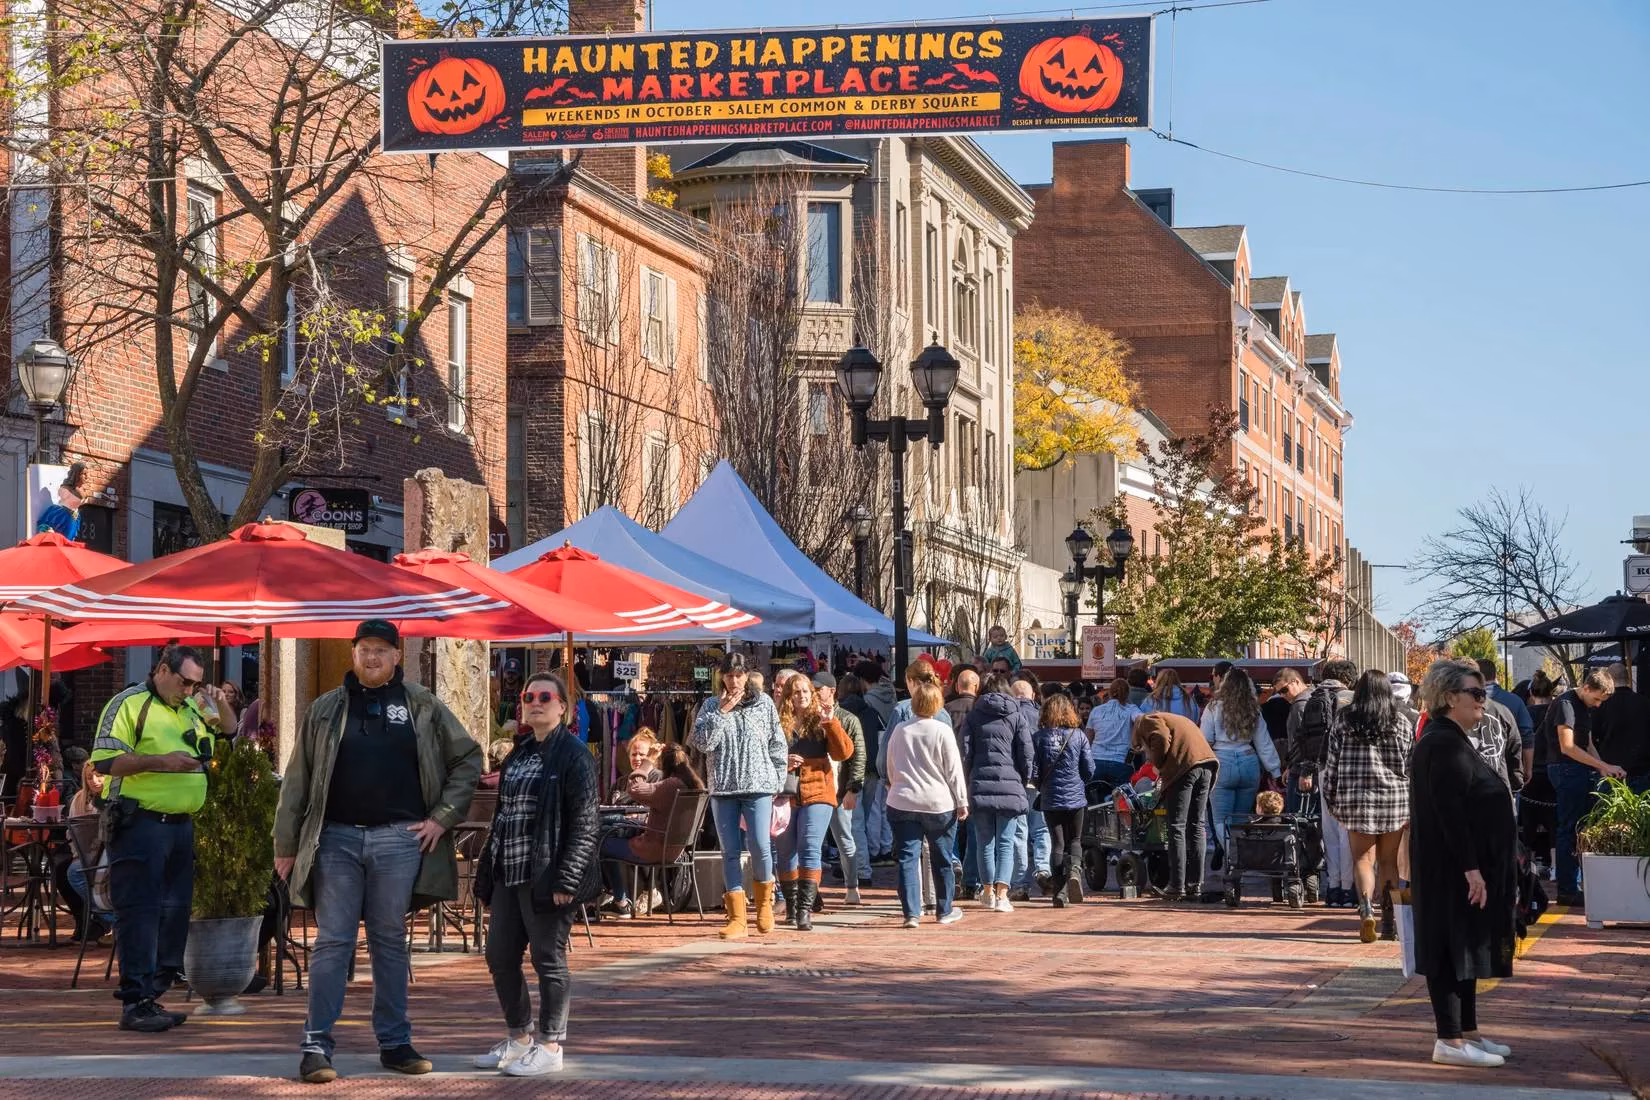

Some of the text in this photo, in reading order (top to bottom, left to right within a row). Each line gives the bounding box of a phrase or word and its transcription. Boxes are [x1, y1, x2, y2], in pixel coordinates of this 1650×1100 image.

[523, 30, 1003, 74] HAUNTED HAPPENINGS
[602, 65, 920, 101] MARKETPLACE
[545, 96, 979, 122] WEEKENDS IN OCTOBER SALEM COMMON & DERBY SQUARE
[635, 115, 1001, 138] HAUNTEDHAPPENINGSMARKETPLACE.COM @HAUNTEDHAPPENINGSMARKET
[311, 510, 363, 521] COON'S
[347, 522, 363, 530] SHOP
[1027, 633, 1066, 647] Salem
[1035, 646, 1055, 658] Fiv
[616, 666, 637, 676] $25
